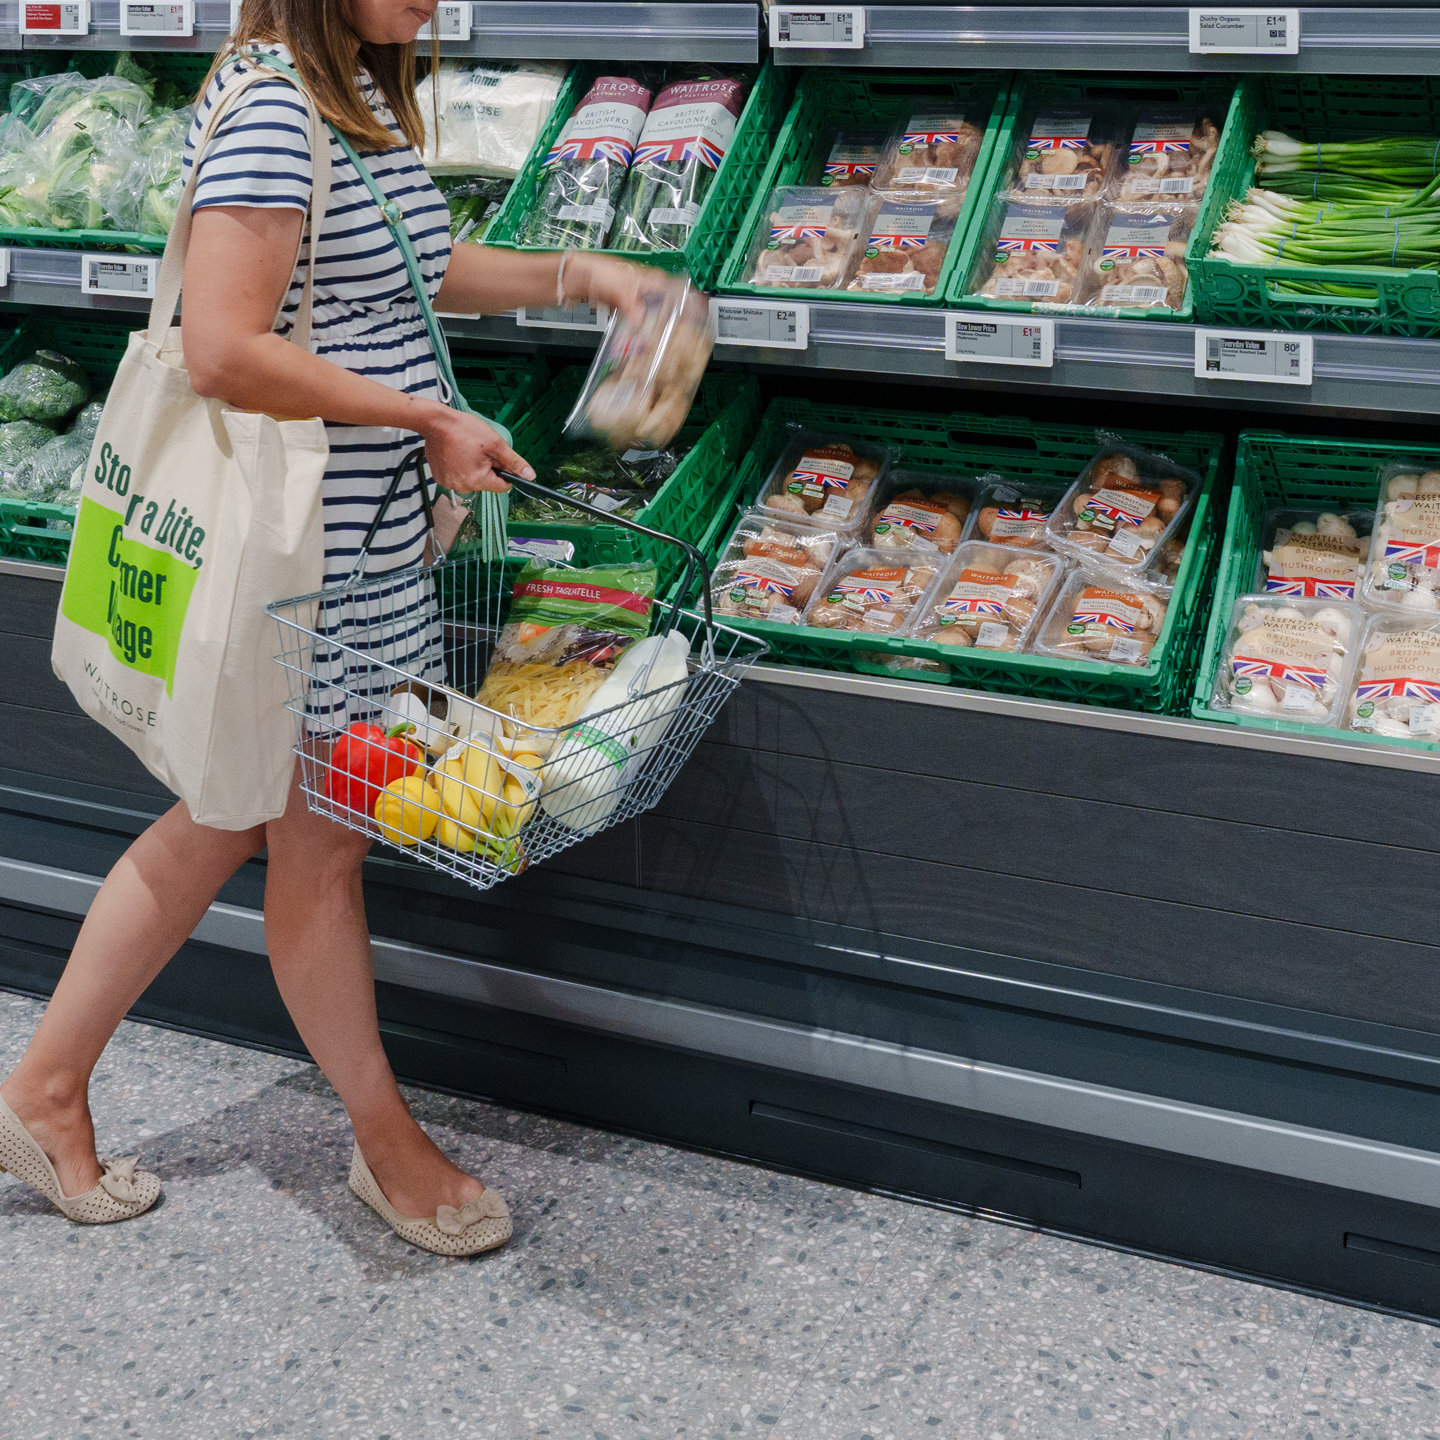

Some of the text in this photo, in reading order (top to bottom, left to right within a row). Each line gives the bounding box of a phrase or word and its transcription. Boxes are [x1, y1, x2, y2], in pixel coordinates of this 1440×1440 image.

[670, 82, 737, 95] WAITROSE
[585, 109, 616, 119] BRITISH
[675, 109, 706, 119] BRITISH
[602, 116, 629, 125] NERO
[657, 116, 717, 127] CAVOLO NERO
[718, 314, 749, 322] Mushrooms
[719, 308, 744, 316] Waitrose
[956, 322, 1041, 337] New Lower Price £1.10
[1221, 340, 1260, 350] Everyday Value
[1106, 494, 1140, 511] MUSHROOMS
[1121, 494, 1150, 510] CHESTNUT
[140, 499, 159, 536] a
[154, 498, 206, 570] bite,
[1292, 532, 1344, 544] ESSENTIAL
[1291, 536, 1344, 552] WAITROSE
[1296, 547, 1335, 559] BRITISH
[1281, 562, 1347, 576] MUSHROOMS
[971, 573, 1008, 581] WAITROSE
[526, 583, 601, 600] FRESH TAGLIATELLE
[1094, 588, 1134, 603] WAITROSE
[1264, 614, 1321, 628] ESSENTIAL
[1262, 621, 1319, 634] WAITROSE
[1266, 633, 1309, 645] BRITISH
[1274, 640, 1296, 649] CUP
[1386, 637, 1440, 648] WAITROSE
[1390, 649, 1430, 657] BRITISH
[1374, 664, 1440, 675] MUSHROOMS
